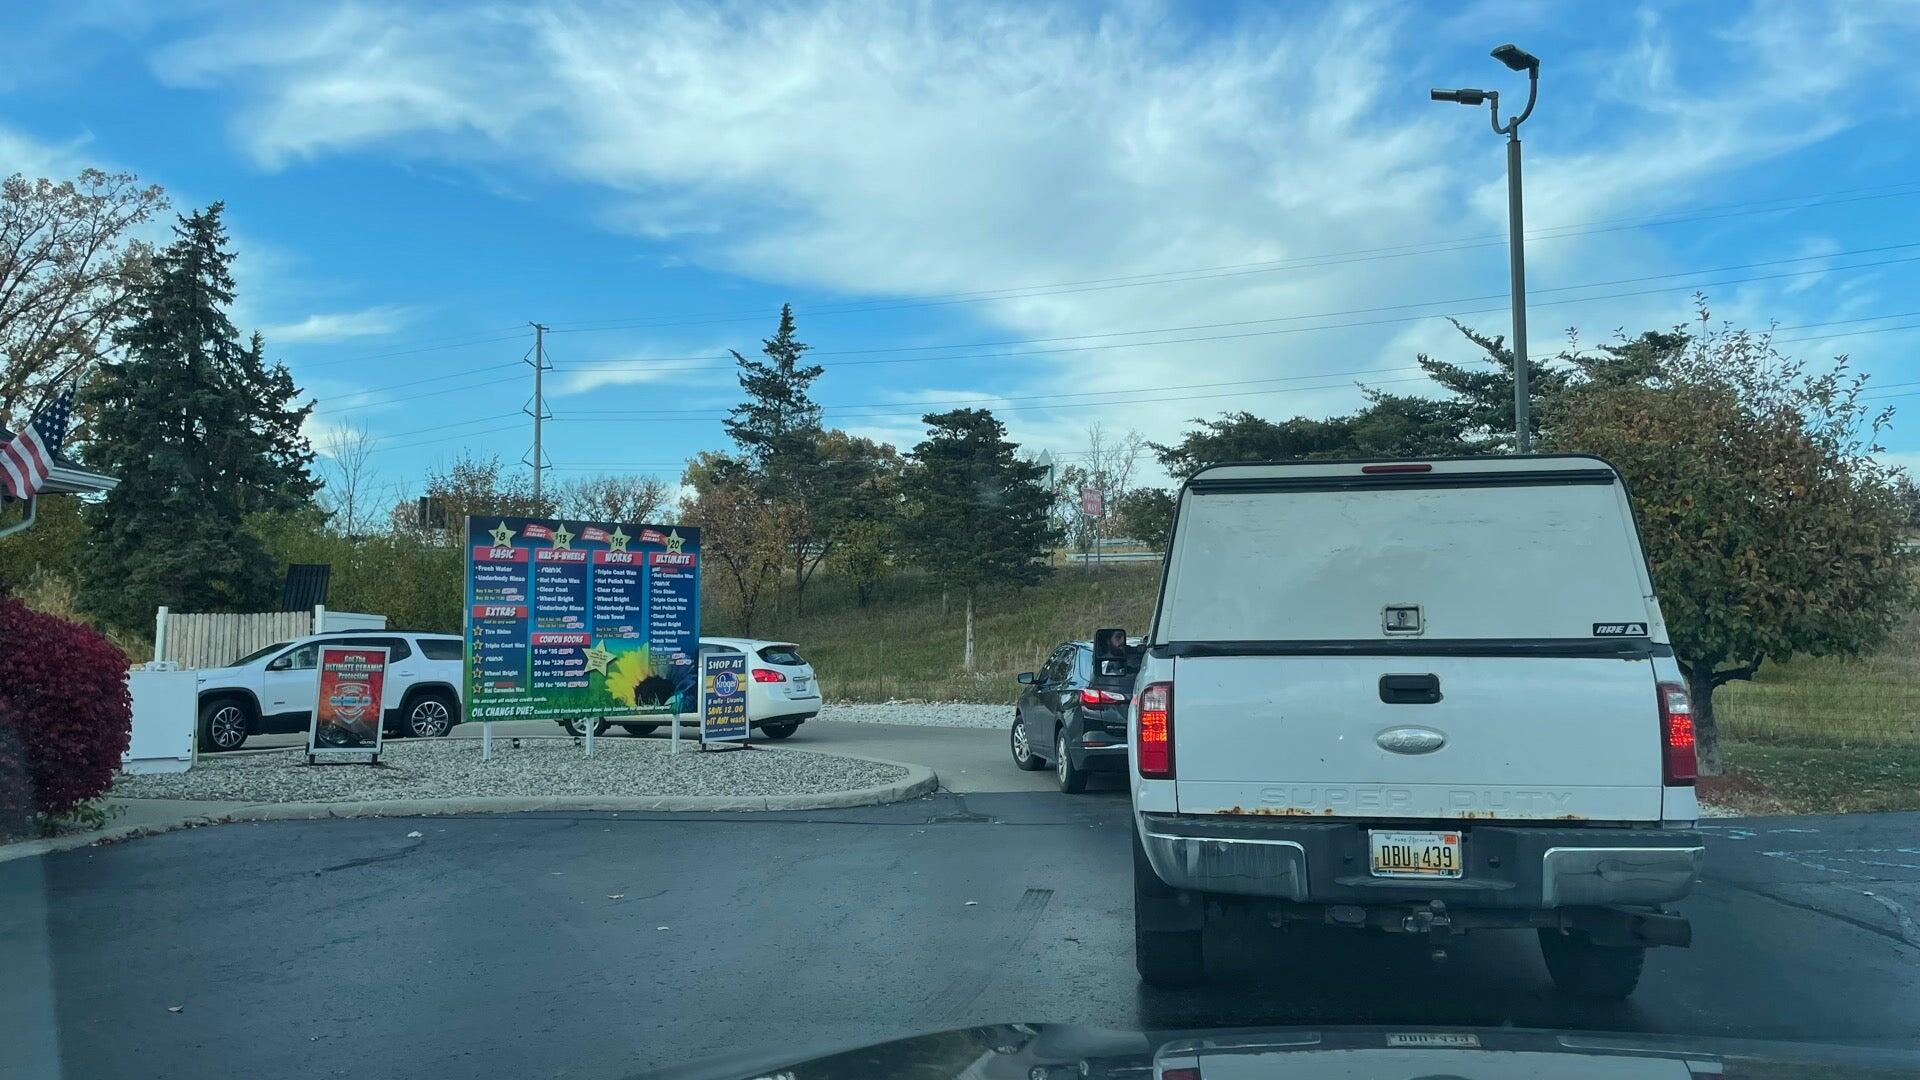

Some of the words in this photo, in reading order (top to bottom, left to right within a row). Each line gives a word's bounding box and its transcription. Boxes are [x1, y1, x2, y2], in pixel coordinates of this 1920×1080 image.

[496, 531, 506, 541] $8
[555, 533, 567, 544] $13
[612, 537, 623, 547] $16
[667, 538, 680, 549] $20
[489, 549, 515, 559] BASIC
[604, 553, 632, 563] WORKS
[655, 555, 691, 564] ULTIMATE
[486, 607, 516, 616] EXTRAS
[539, 635, 562, 643] COUPON
[563, 635, 584, 643] BOOKS
[708, 661, 729, 669] SHOP
[732, 660, 744, 668] AT
[716, 675, 736, 693] Kroger
[472, 707, 484, 717] OIL
[485, 707, 515, 716] CHANGE
[516, 706, 534, 715] DUE?
[708, 707, 722, 715] SAVE
[1260, 787, 1413, 810] SUPER
[1448, 789, 1574, 811] DUTY
[1382, 845, 1411, 866] DBU
[1422, 846, 1452, 867] 439
